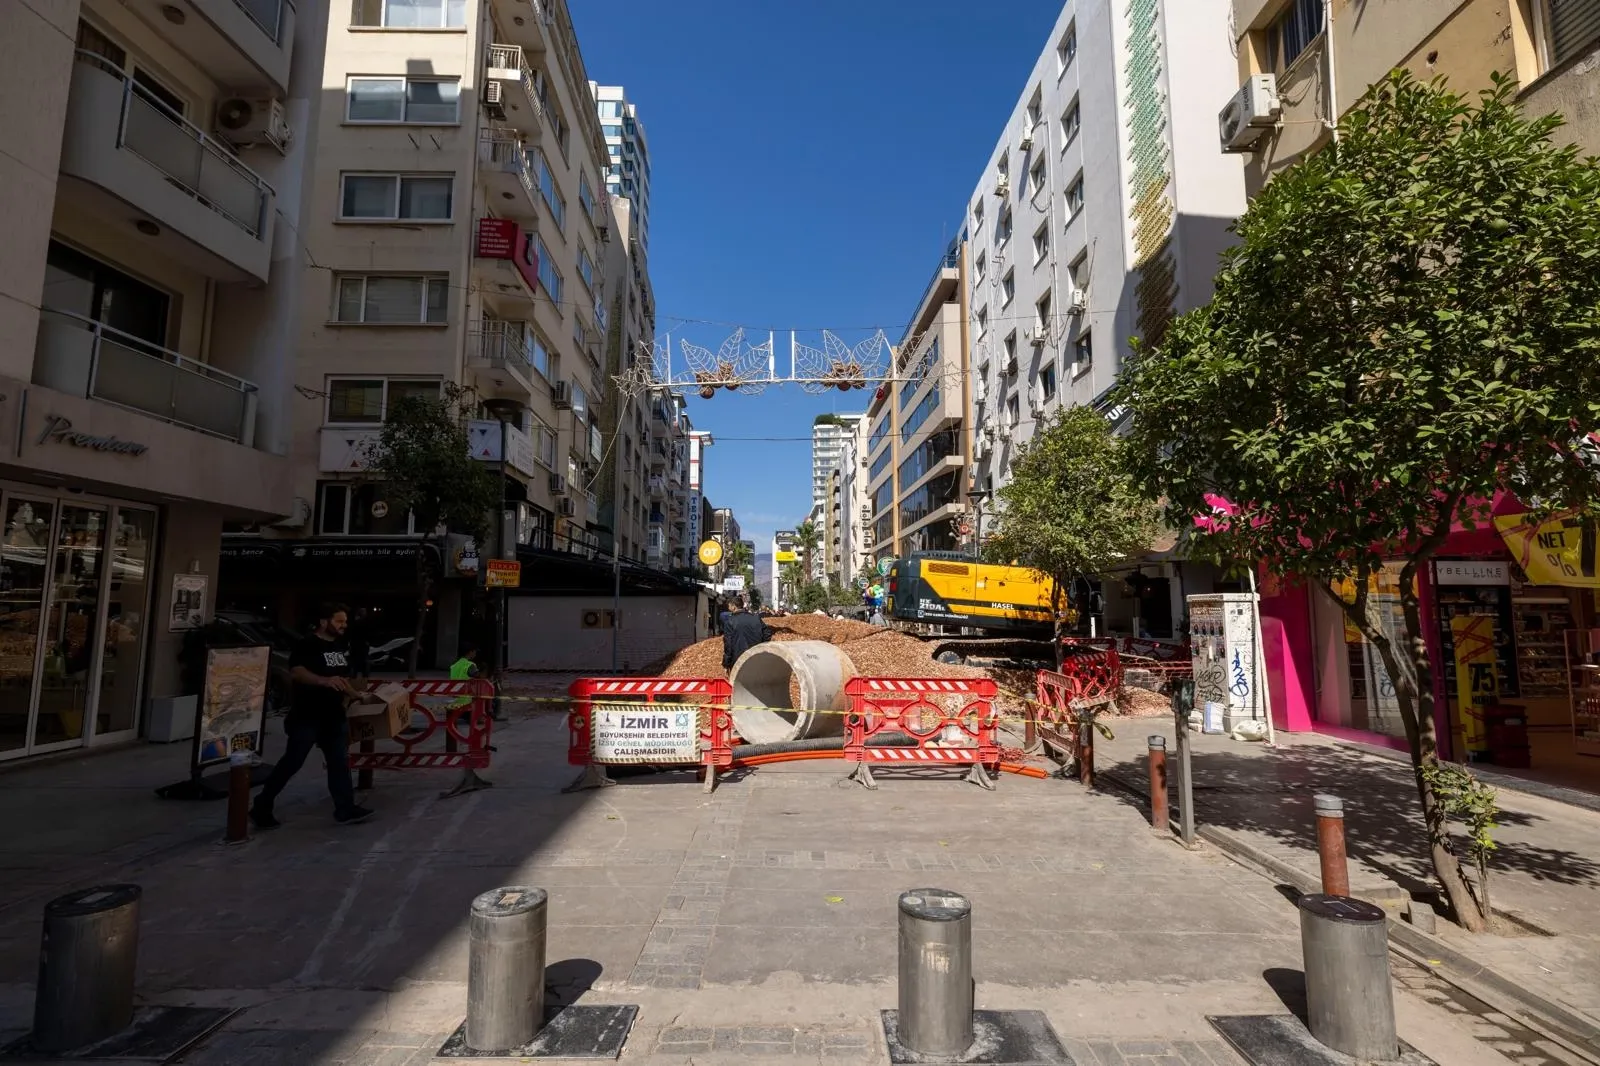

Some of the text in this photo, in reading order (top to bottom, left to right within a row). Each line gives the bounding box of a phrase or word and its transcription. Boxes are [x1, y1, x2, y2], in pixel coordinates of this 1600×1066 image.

[1537, 530, 1565, 549] NET
[991, 602, 1015, 610] HASEL
[620, 715, 668, 729] İZMİR
[613, 748, 676, 756] ÇALIŞMASIDIR
